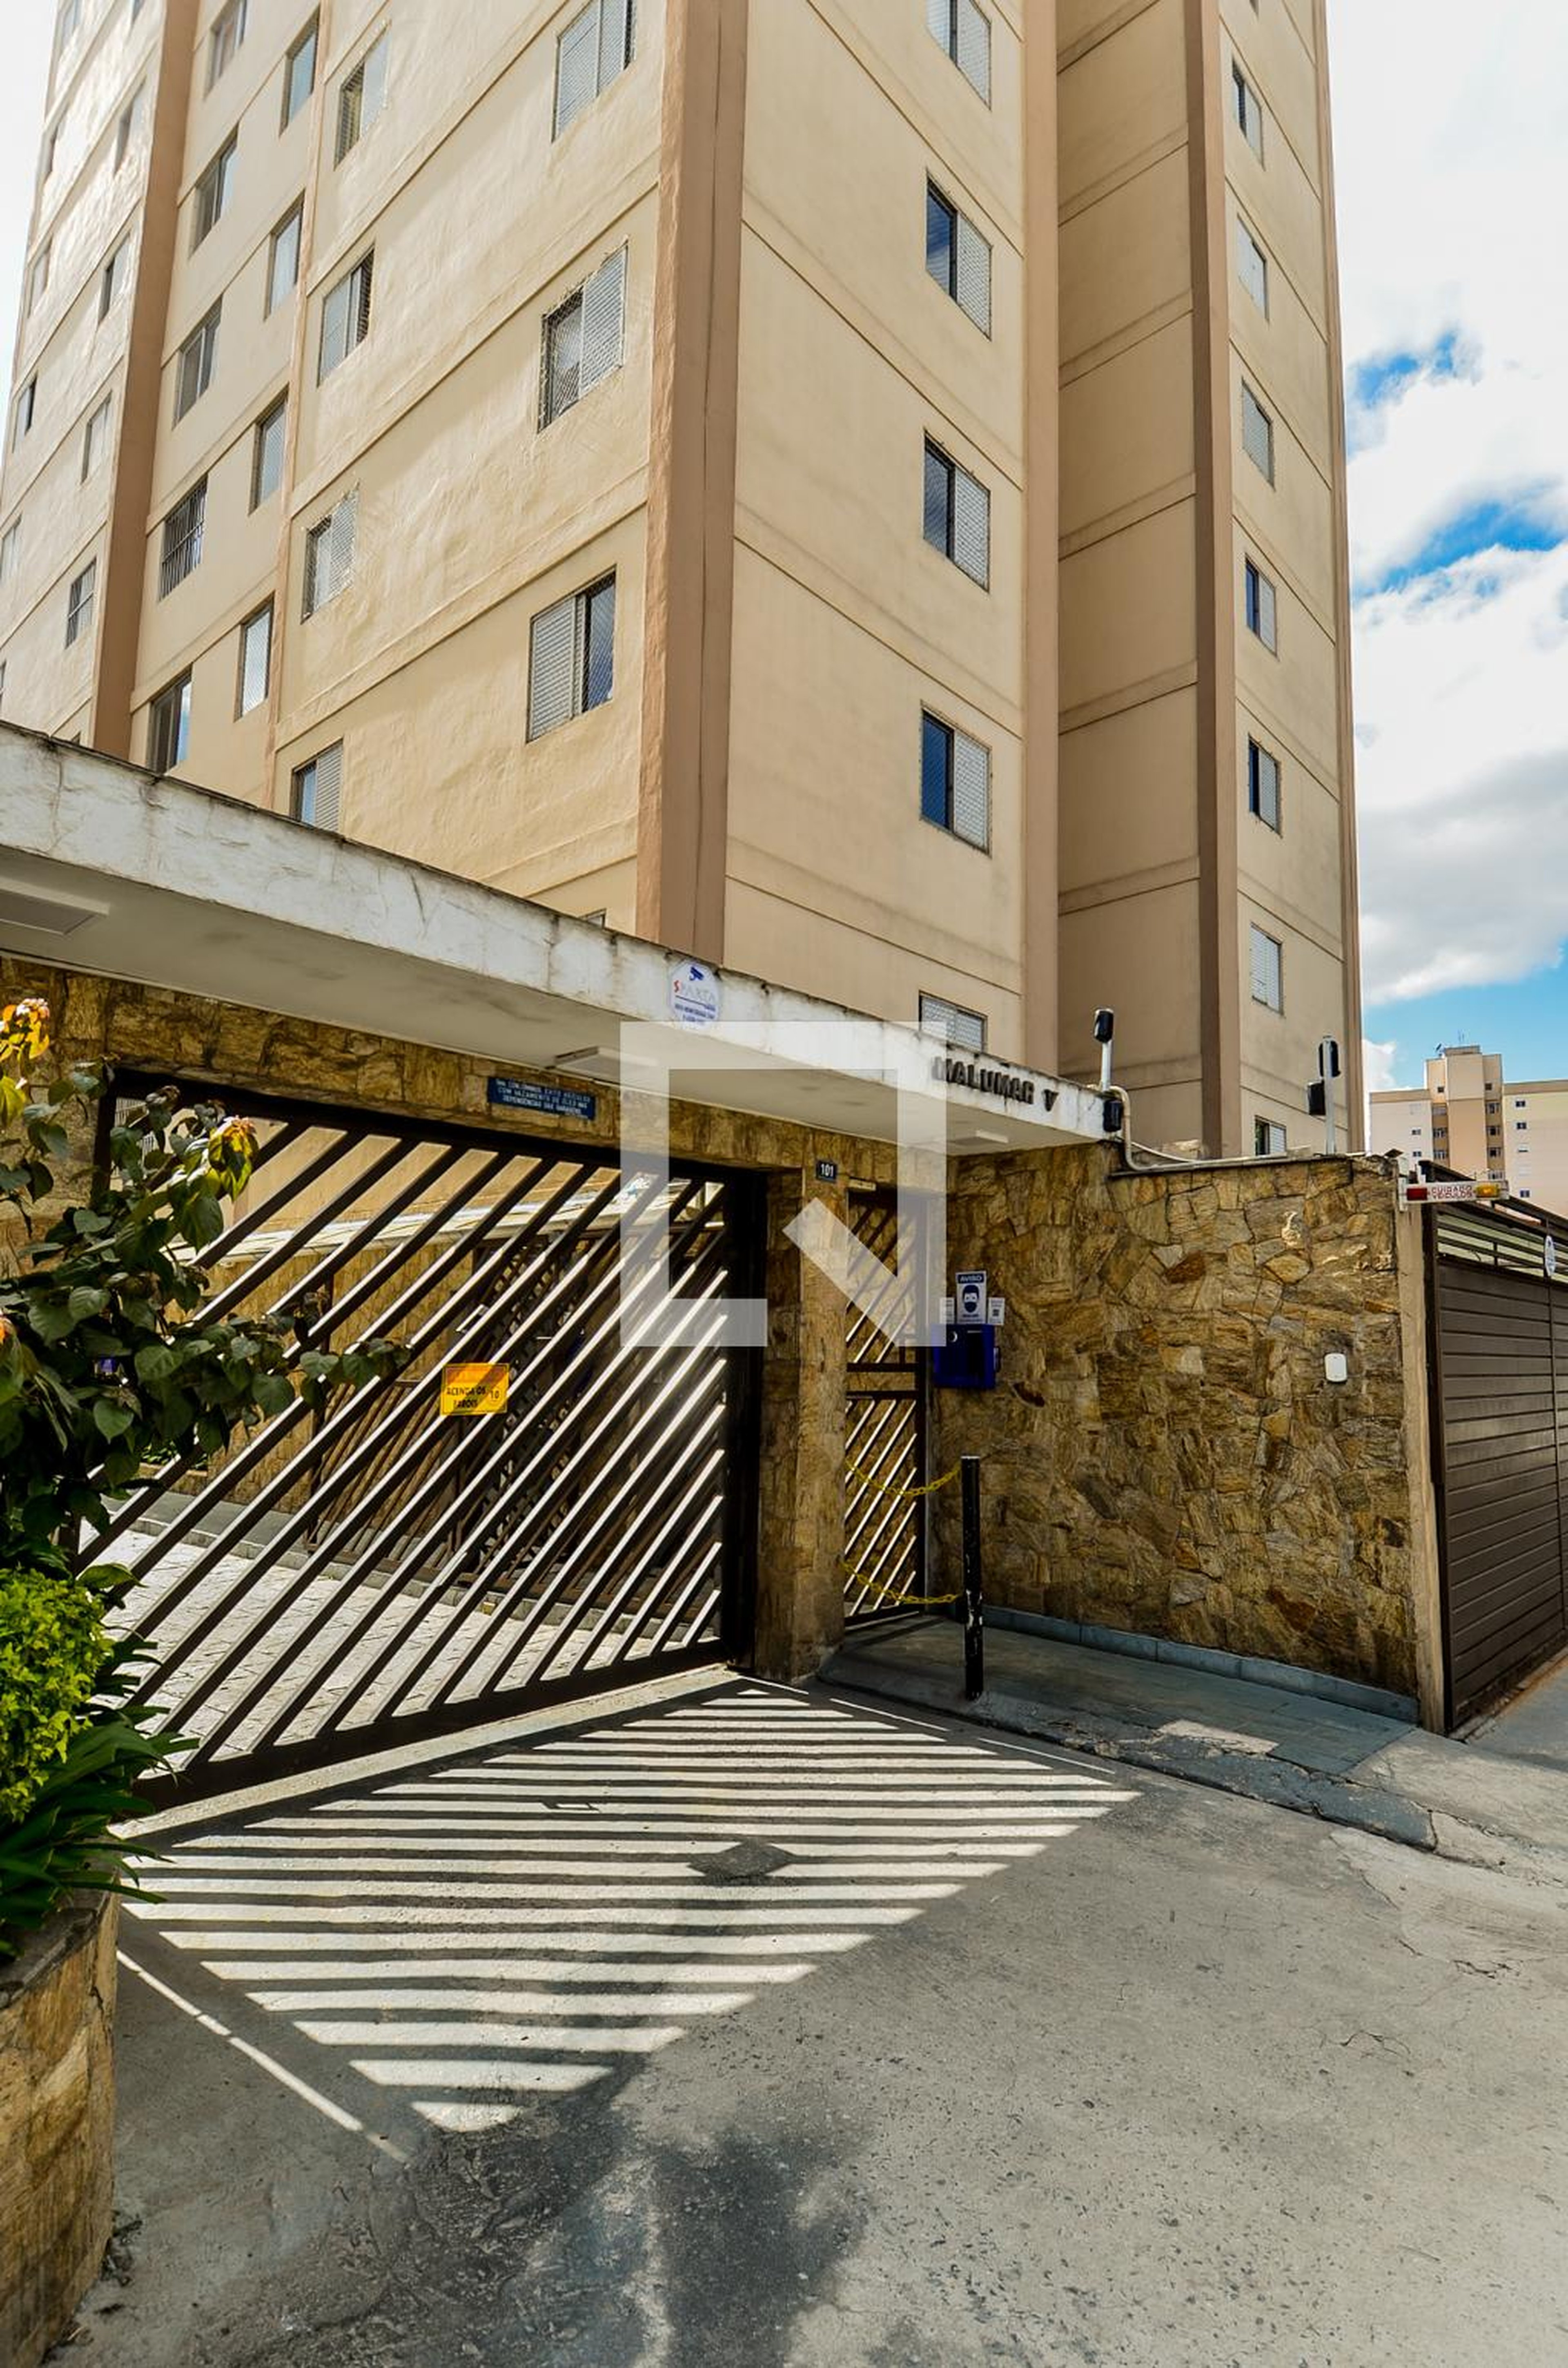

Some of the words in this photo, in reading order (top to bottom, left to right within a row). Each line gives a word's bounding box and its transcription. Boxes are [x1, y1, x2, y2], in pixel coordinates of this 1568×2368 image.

[931, 1056, 1034, 1104] MALUMAR
[1043, 1089, 1059, 1112] V
[821, 1163, 834, 1177] 101
[491, 1390, 499, 1399] 10
